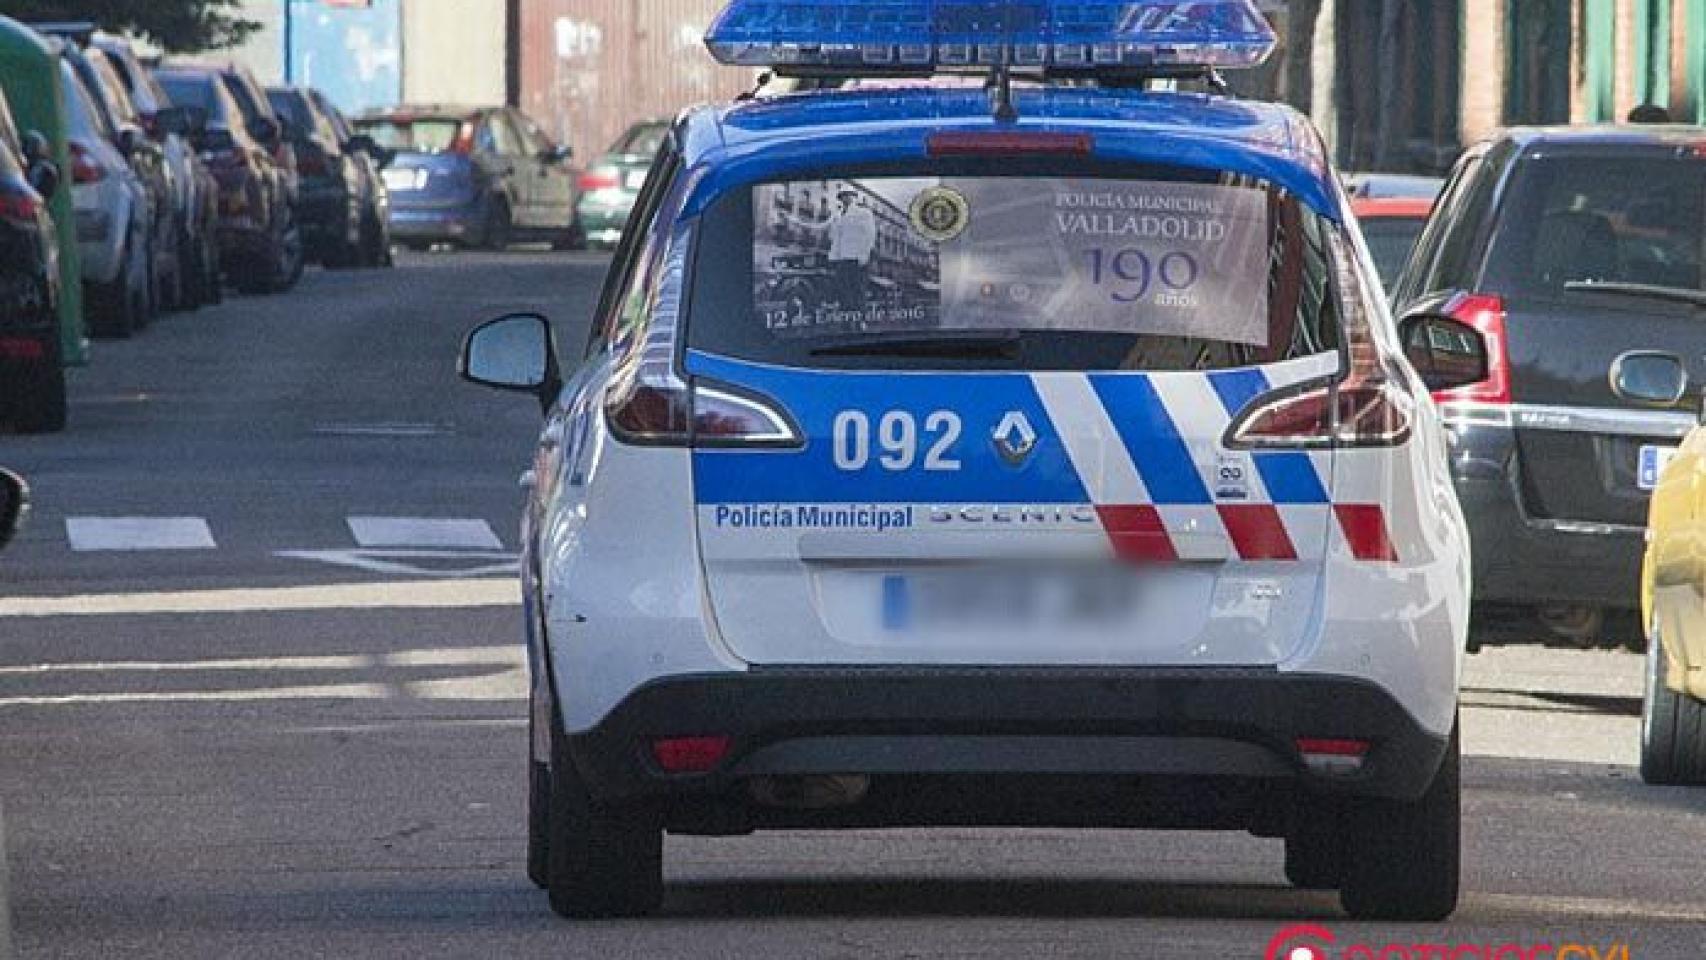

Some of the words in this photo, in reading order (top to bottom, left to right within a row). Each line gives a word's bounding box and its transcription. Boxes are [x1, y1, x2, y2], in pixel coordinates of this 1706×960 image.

[1057, 213, 1225, 241] VALLADOLID
[1083, 247, 1198, 302] 190
[765, 310, 788, 329] 12
[834, 409, 962, 471] 092
[716, 504, 793, 528] Policía
[797, 504, 913, 532] Municipal
